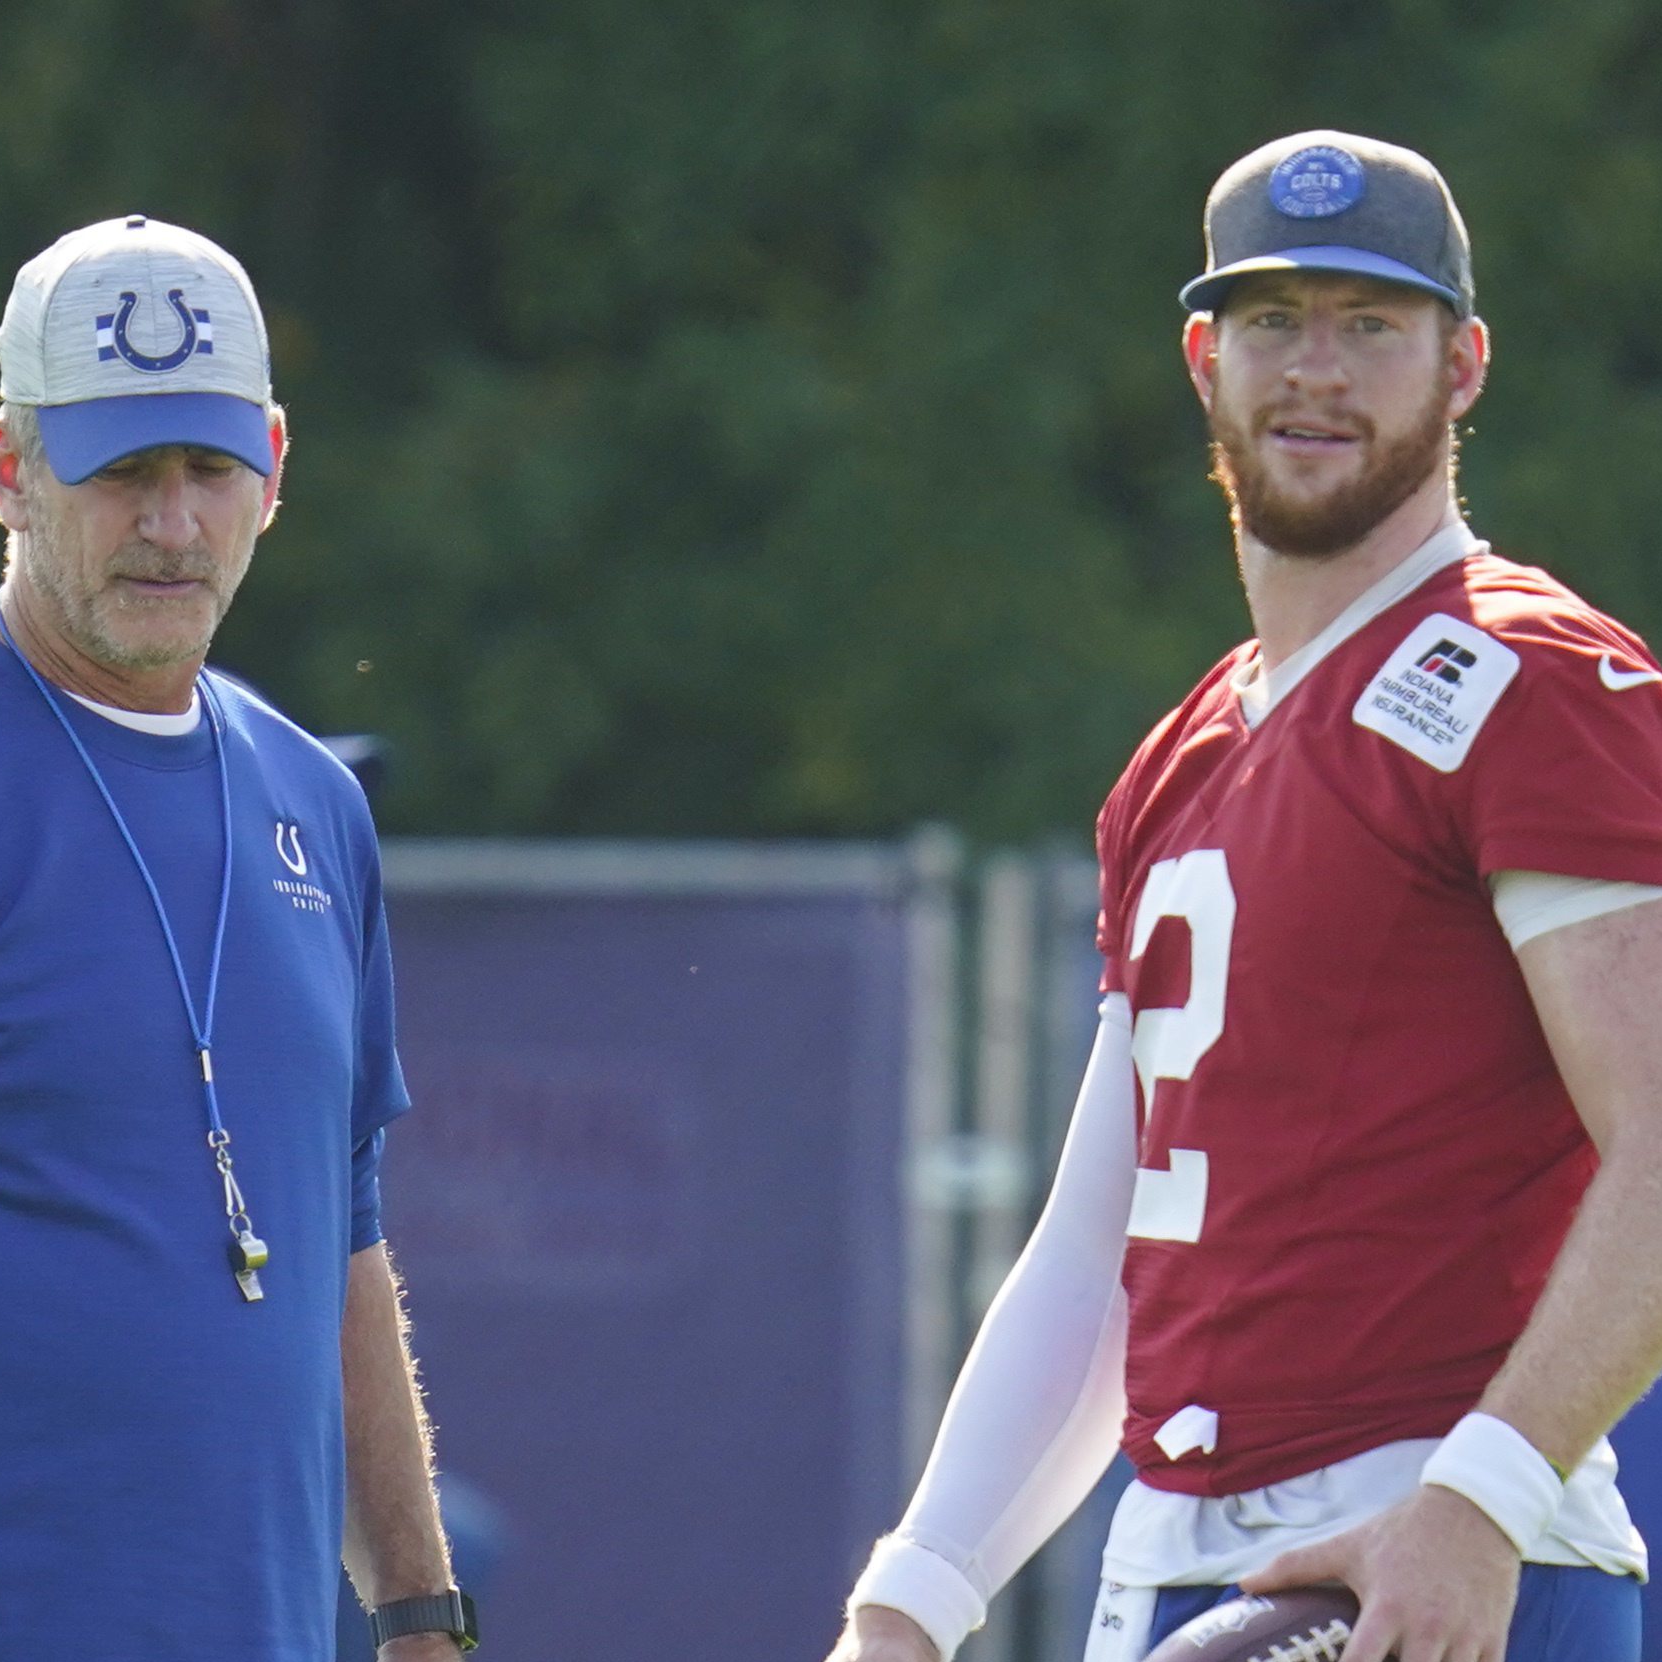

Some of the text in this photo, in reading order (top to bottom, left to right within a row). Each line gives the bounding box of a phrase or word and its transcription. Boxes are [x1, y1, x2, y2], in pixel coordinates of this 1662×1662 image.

[1290, 172, 1343, 192] COLTS
[1399, 668, 1455, 706] INDIANA
[1126, 848, 1237, 1244] 2
